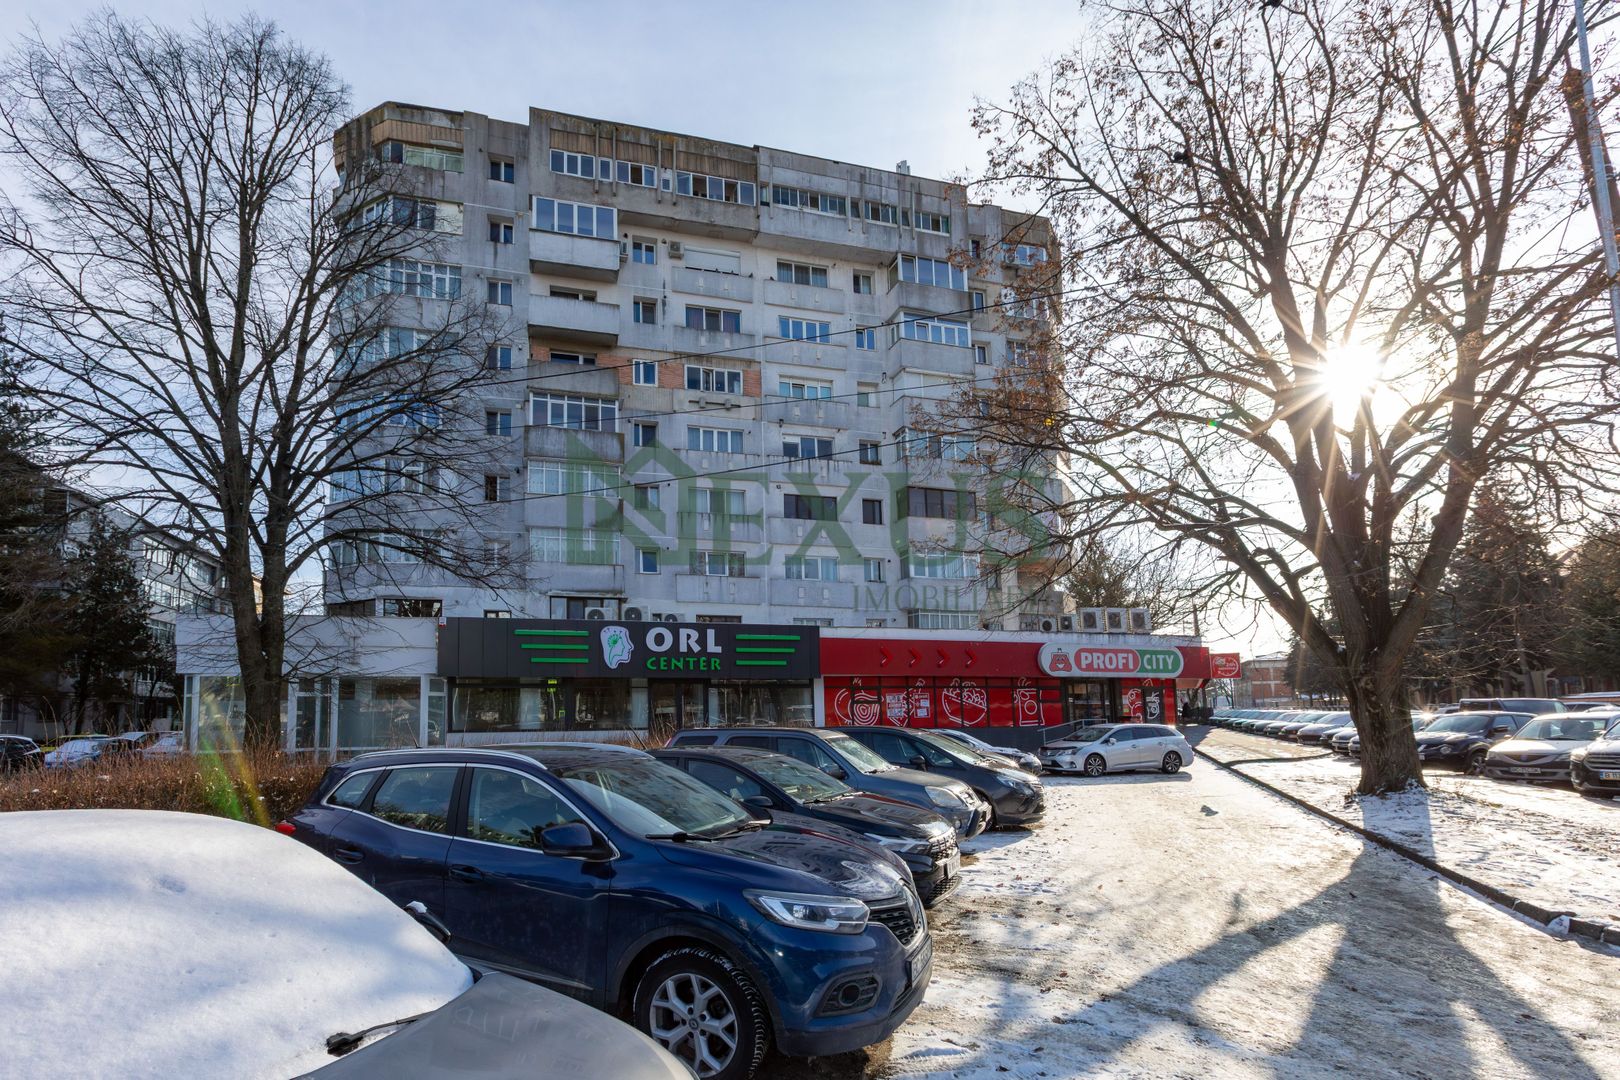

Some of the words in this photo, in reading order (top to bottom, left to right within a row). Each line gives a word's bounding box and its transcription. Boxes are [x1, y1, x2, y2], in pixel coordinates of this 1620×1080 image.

[645, 626, 722, 653] ORL
[646, 656, 721, 671] CENTER
[1080, 651, 1134, 669] PROFI
[1143, 654, 1174, 669] CITY
